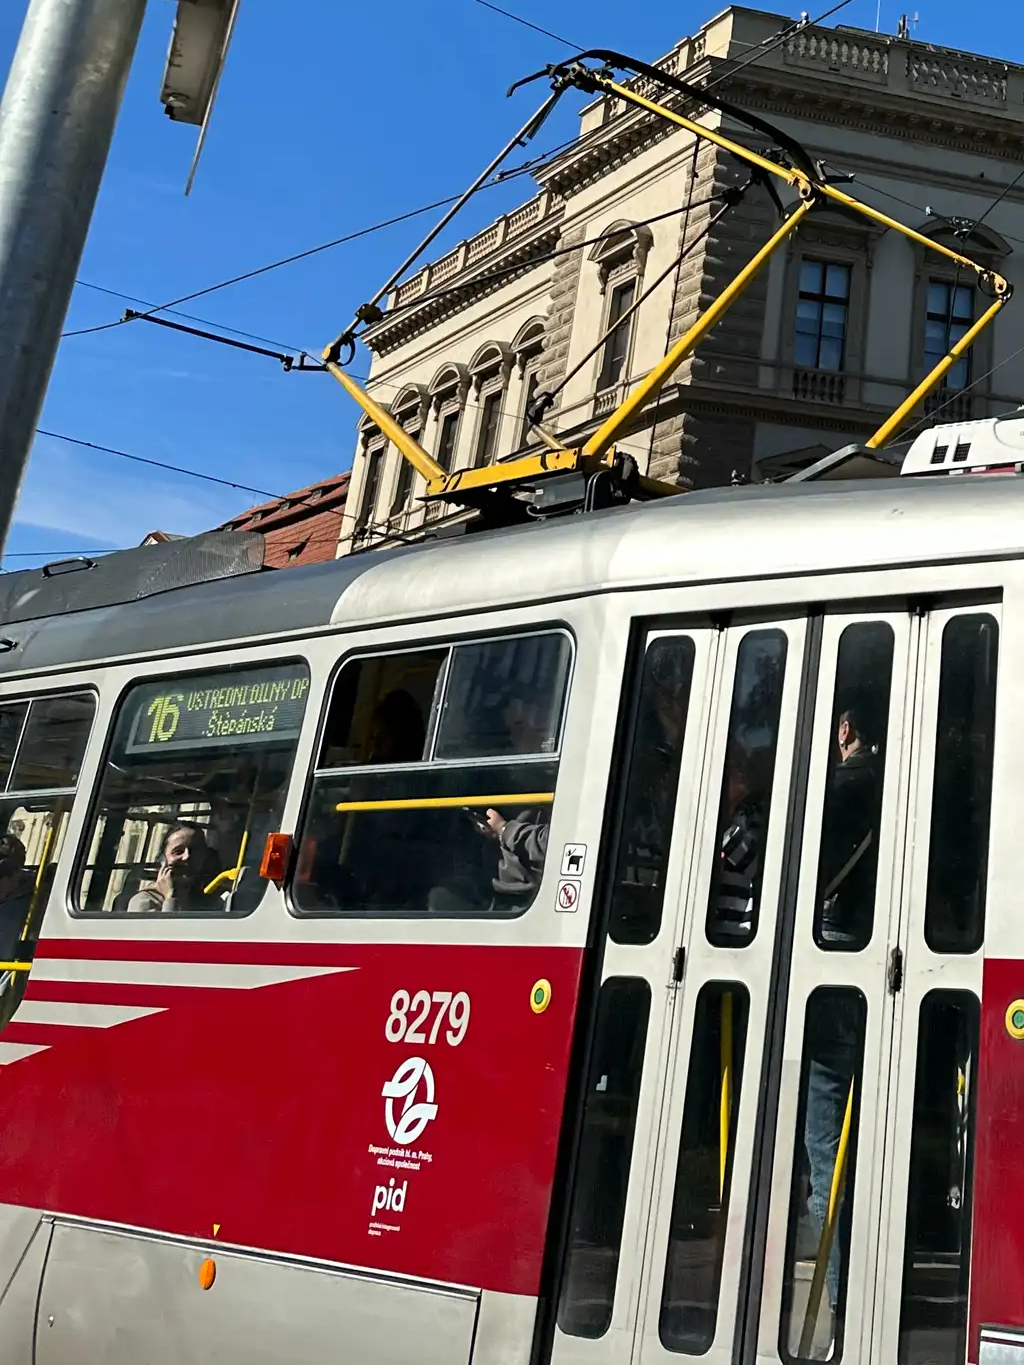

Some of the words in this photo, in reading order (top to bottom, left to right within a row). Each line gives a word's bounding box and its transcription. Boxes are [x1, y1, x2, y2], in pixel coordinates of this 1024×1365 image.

[148, 694, 184, 742] 16
[384, 989, 471, 1046] 8279
[371, 1177, 408, 1216] pid
